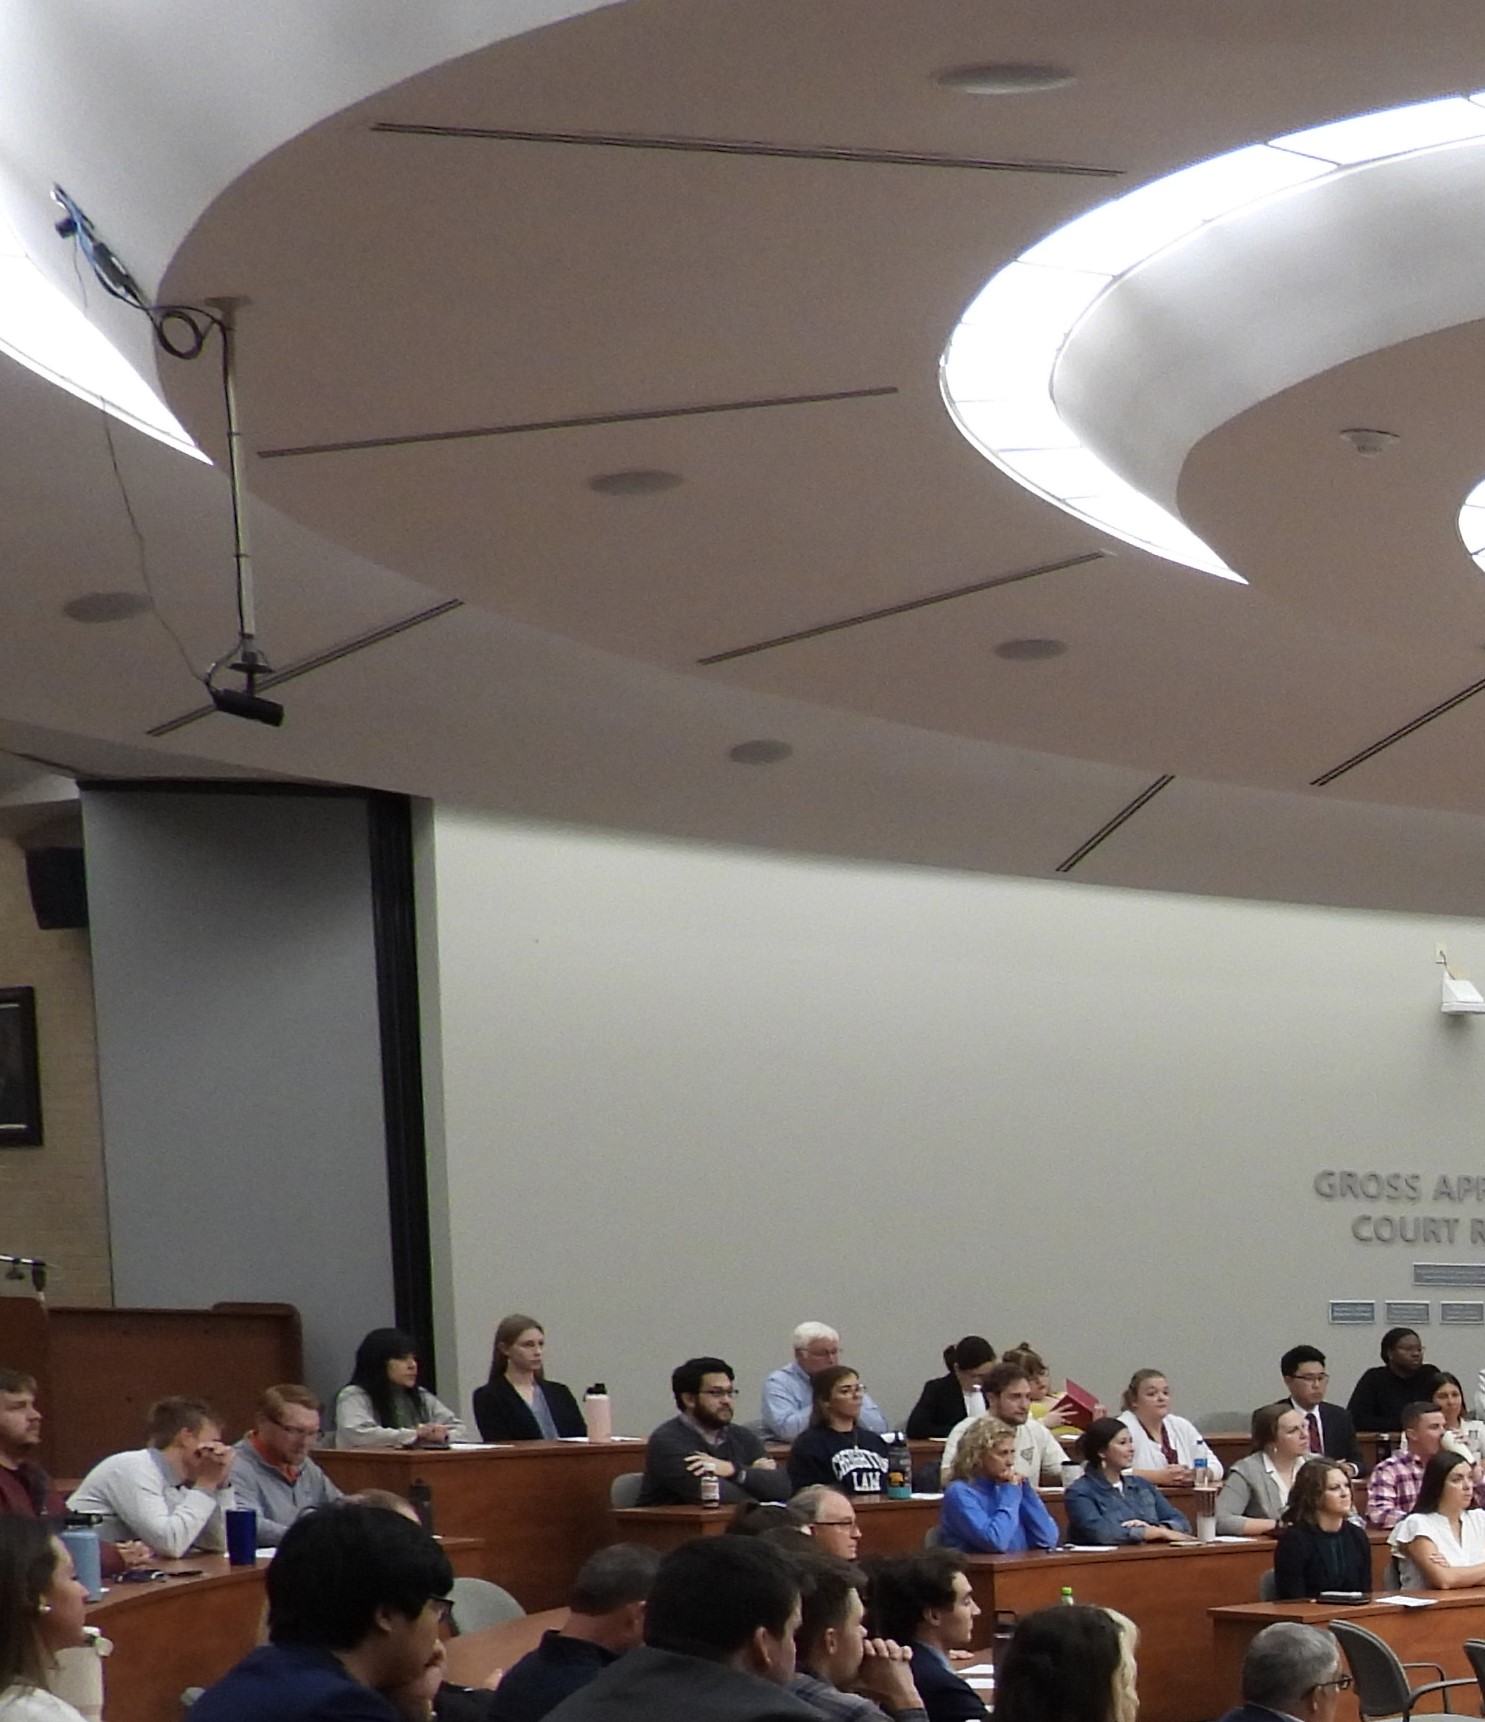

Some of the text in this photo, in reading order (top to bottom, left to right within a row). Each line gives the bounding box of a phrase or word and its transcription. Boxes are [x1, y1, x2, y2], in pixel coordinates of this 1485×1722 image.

[1313, 1169, 1421, 1201] GROSS
[1351, 1213, 1460, 1244] COURT
[852, 1471, 881, 1491] LAW
